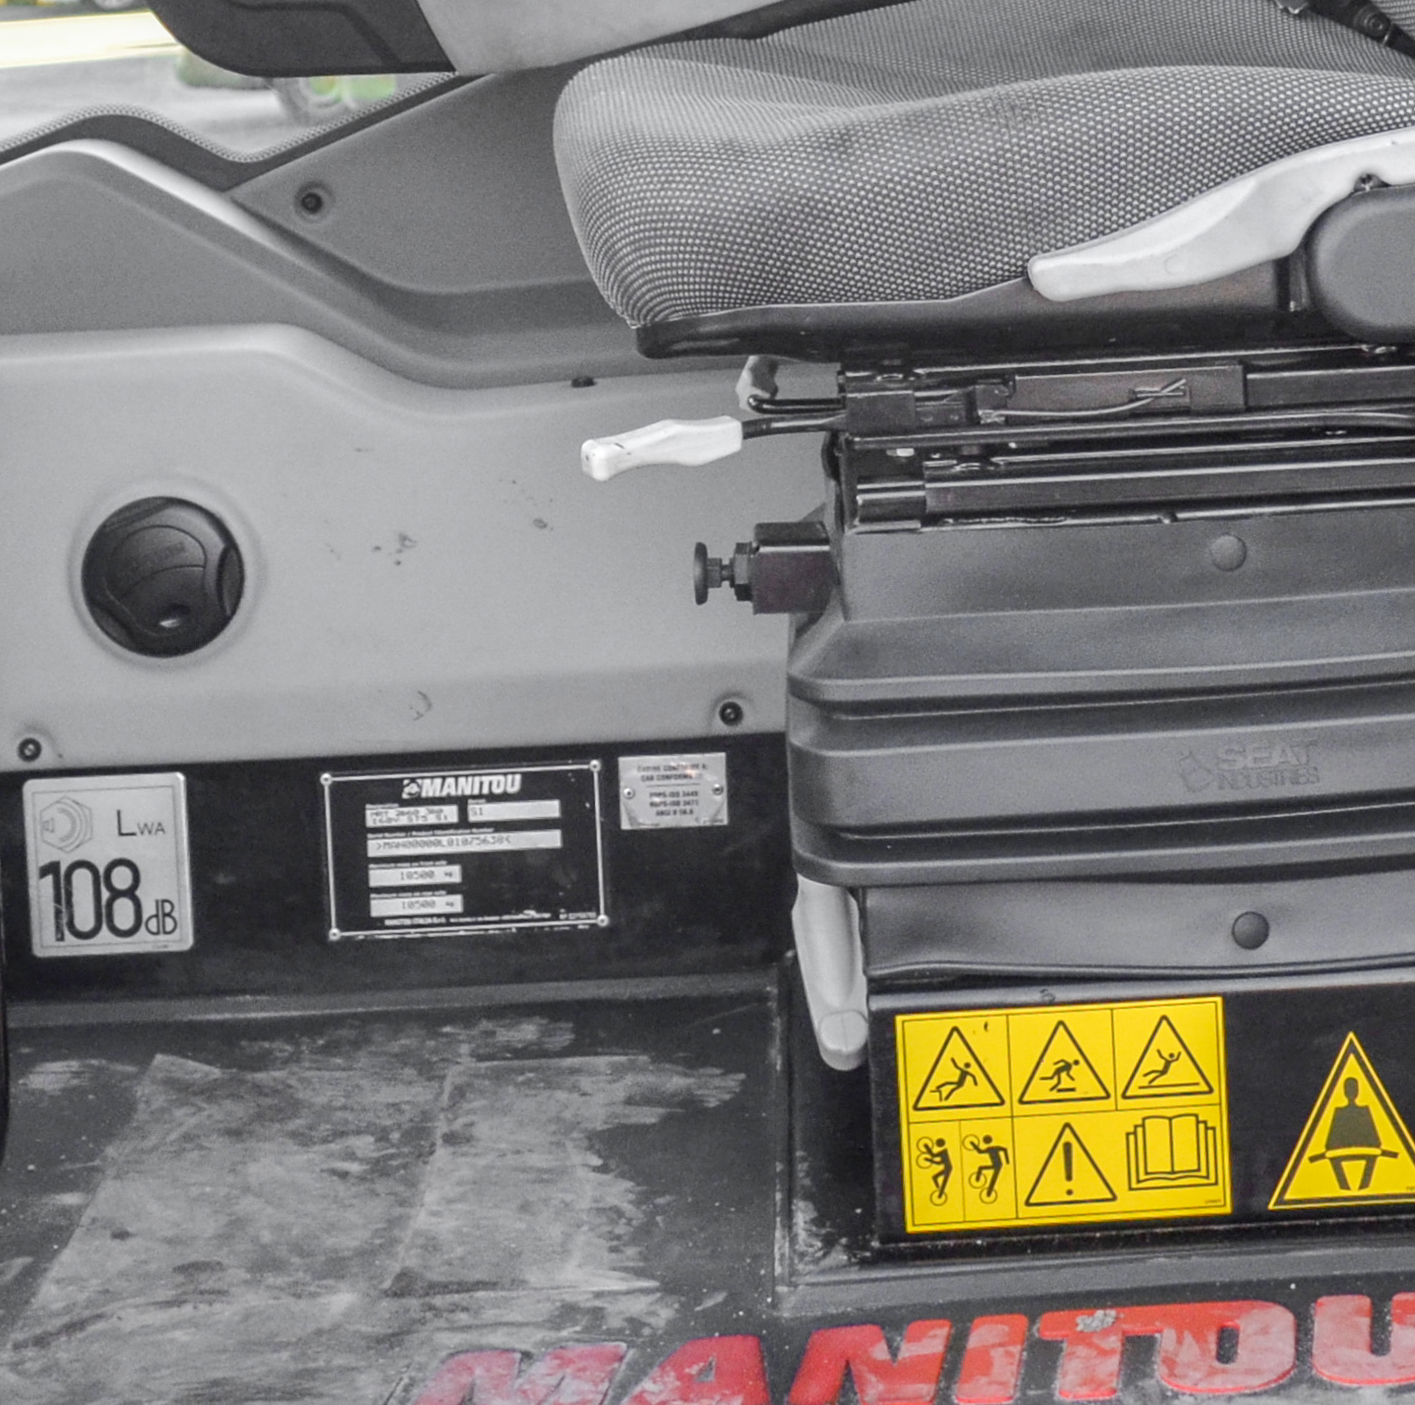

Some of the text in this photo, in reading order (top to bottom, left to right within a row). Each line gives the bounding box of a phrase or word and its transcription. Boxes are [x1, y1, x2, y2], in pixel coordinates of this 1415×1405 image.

[1217, 737, 1318, 770] SEAT
[421, 773, 522, 798] MANITOU
[1217, 766, 1320, 791] INDUSTRIES
[470, 807, 484, 816] S1
[400, 870, 435, 881] 10500
[402, 899, 436, 909] 10500
